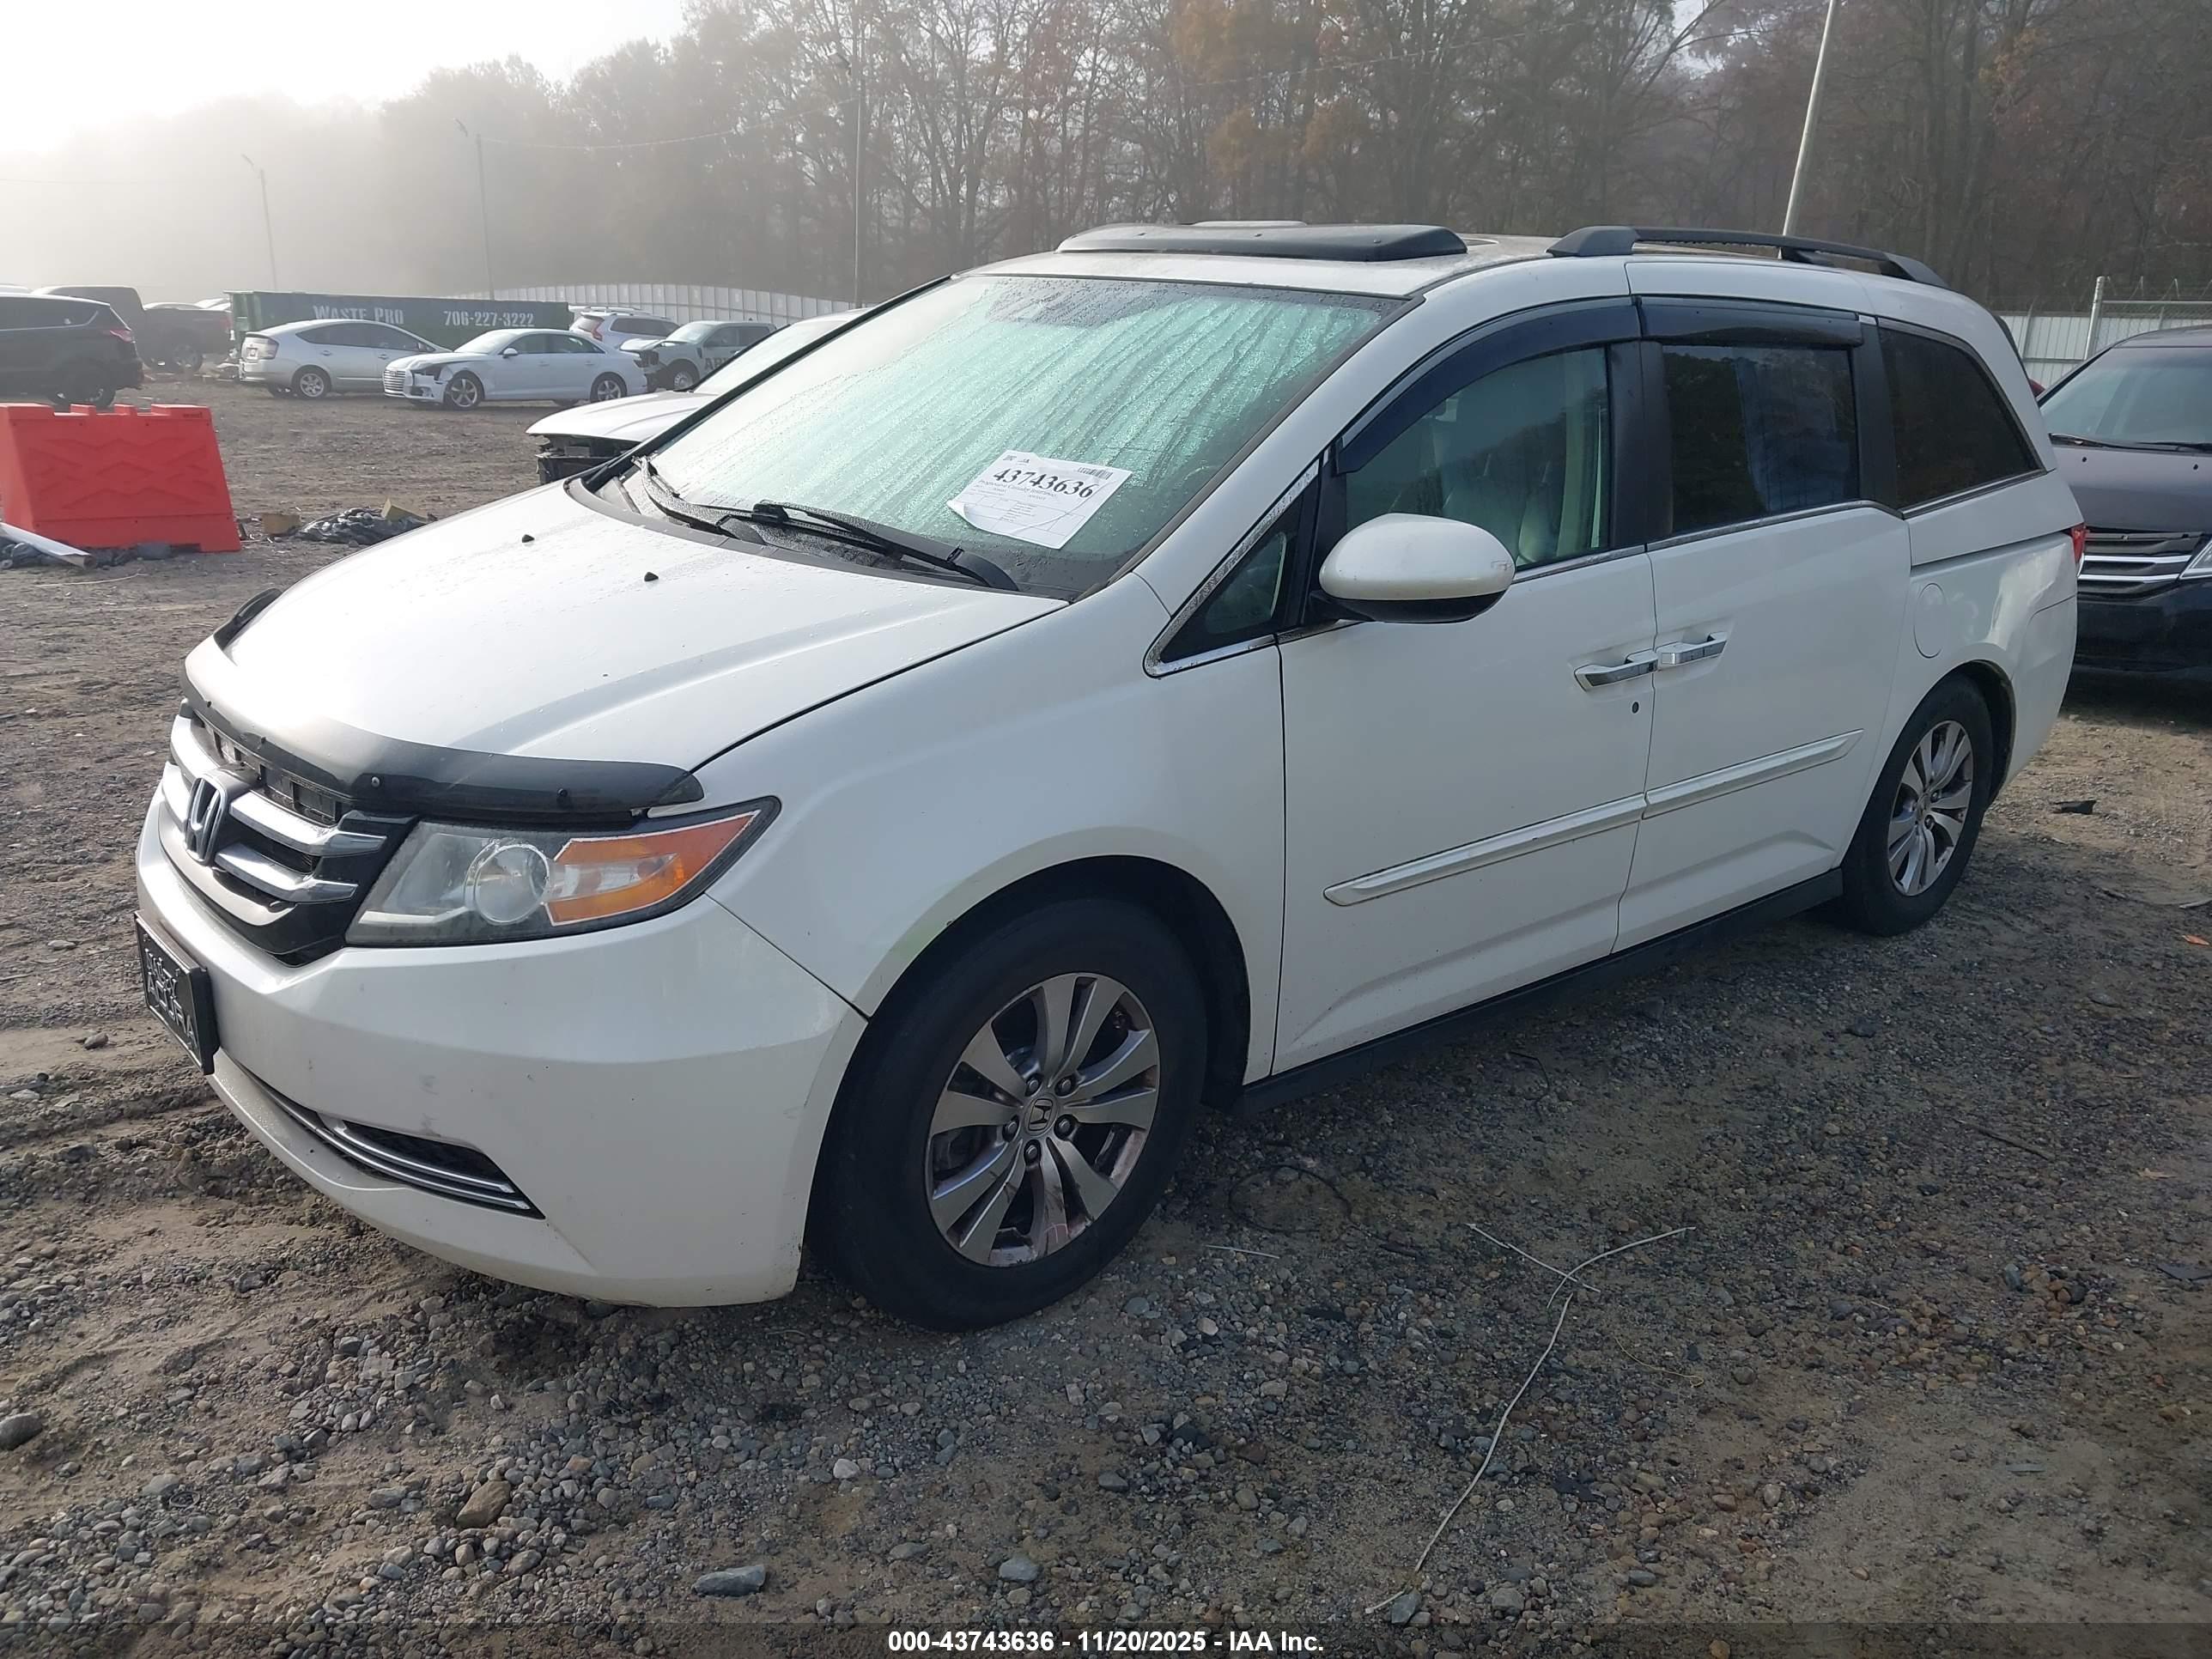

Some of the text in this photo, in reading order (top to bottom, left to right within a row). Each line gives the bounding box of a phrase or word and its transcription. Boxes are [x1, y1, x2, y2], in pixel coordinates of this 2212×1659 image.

[374, 307, 404, 325] PRO
[443, 310, 535, 327] 706-227-3222
[994, 468, 1099, 497] 43743636
[147, 971, 198, 1048] ACURA
